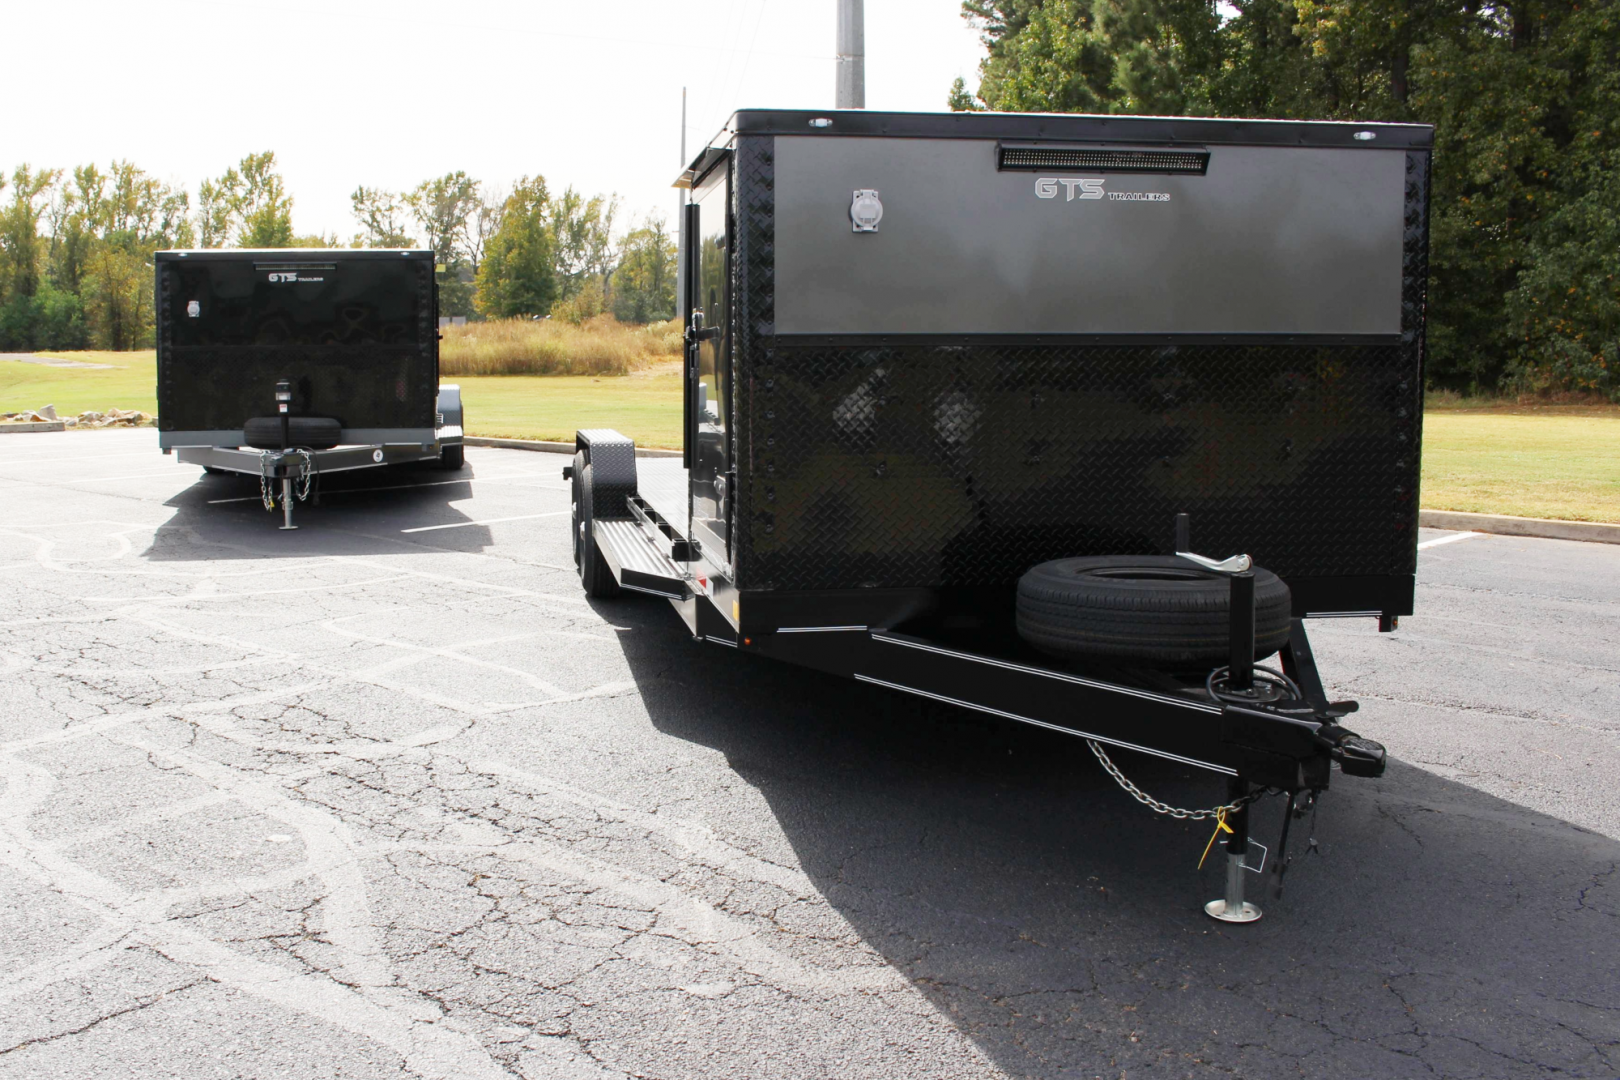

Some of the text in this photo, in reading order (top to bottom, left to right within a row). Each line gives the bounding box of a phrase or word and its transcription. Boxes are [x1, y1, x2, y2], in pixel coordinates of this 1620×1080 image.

[1034, 177, 1170, 202] GTS TRAILERS
[268, 272, 297, 282] GTS
